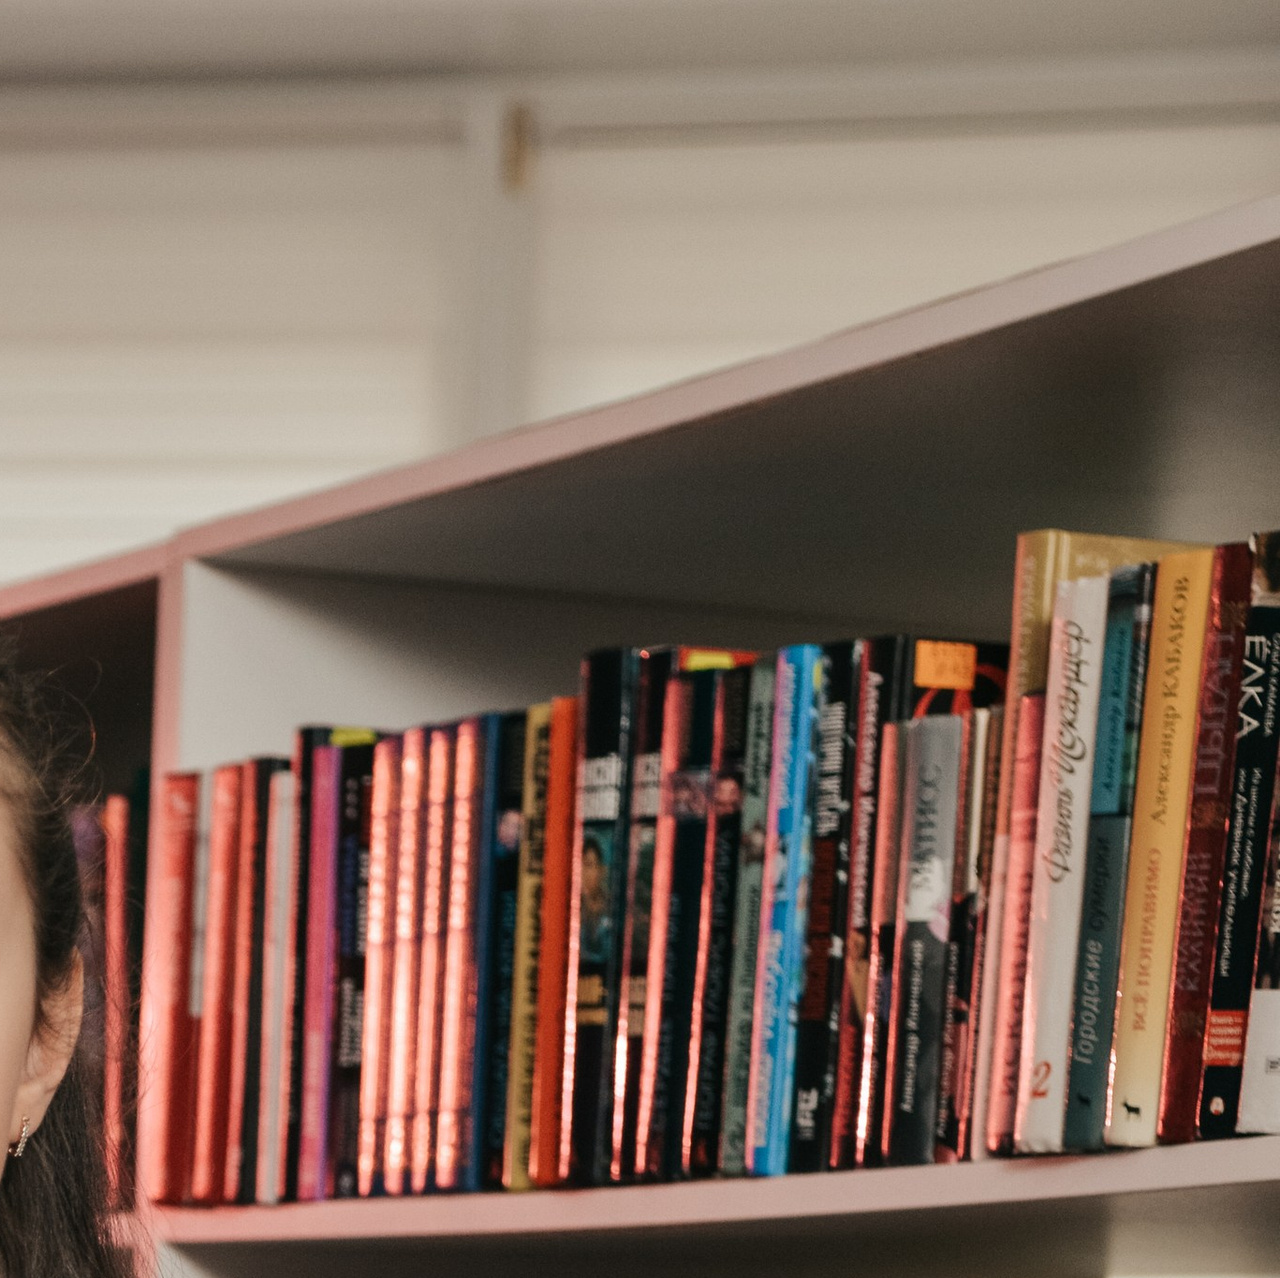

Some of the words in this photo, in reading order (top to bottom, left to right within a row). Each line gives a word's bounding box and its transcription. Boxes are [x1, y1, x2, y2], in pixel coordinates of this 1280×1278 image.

[1162, 575, 1190, 698] КАБАКОВ
[1235, 633, 1272, 739] ЁЛКА
[1052, 620, 1092, 784] Искандер
[1151, 704, 1182, 825] Александр
[1043, 782, 1080, 884] Фазиль
[1137, 848, 1161, 986] ПОПРАВИМО
[1073, 938, 1103, 1064] Городские
[1031, 1061, 1052, 1097] 2
